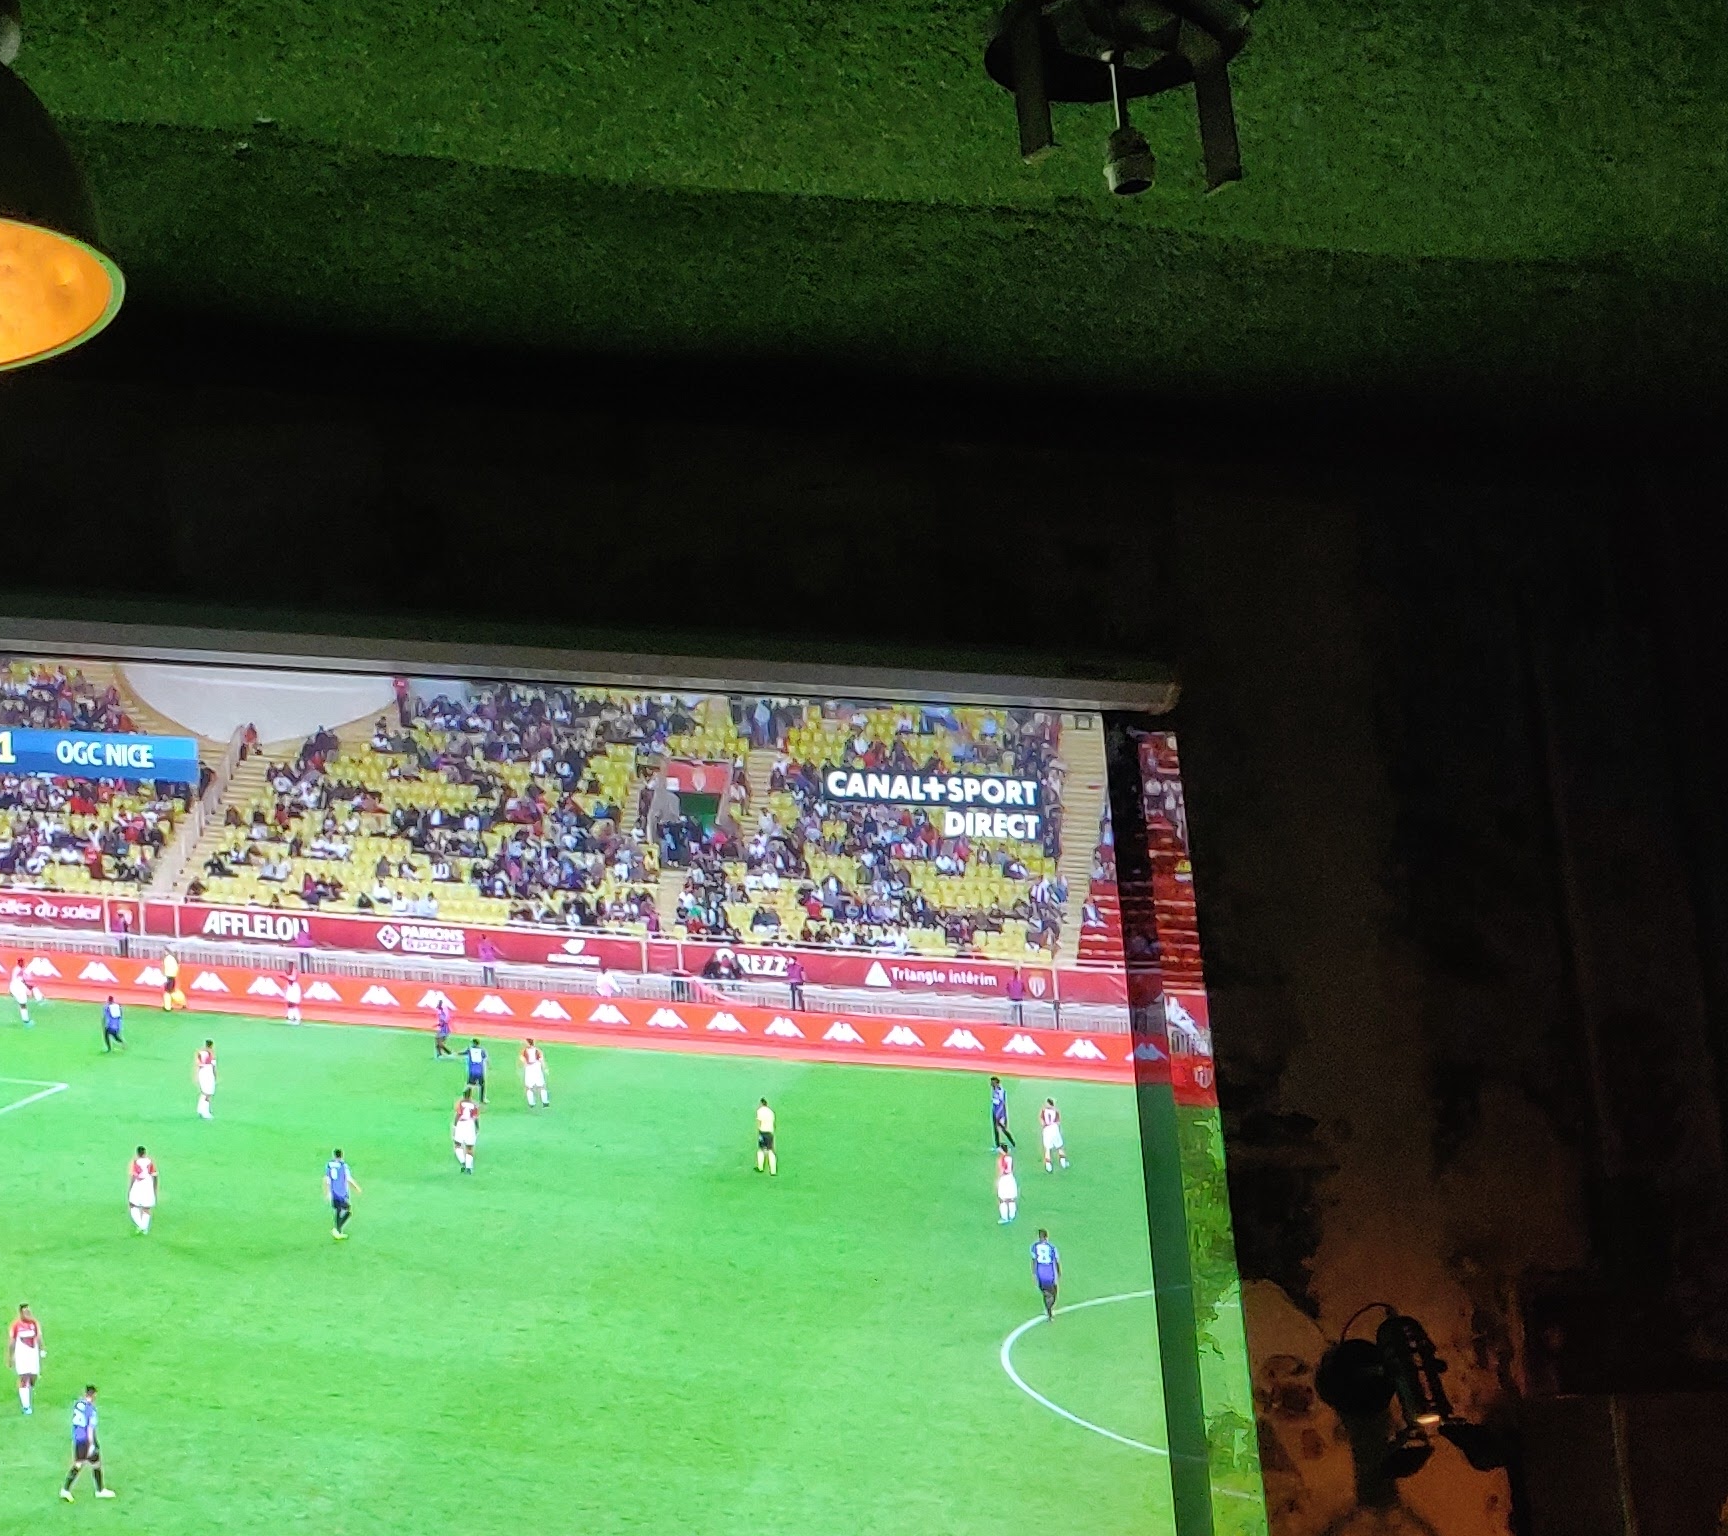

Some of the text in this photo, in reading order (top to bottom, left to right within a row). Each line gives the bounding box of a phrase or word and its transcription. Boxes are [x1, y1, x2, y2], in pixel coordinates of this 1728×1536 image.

[56, 740, 103, 766] OGC
[106, 743, 155, 769] NICE
[827, 770, 1038, 806] CANAL+SPORT
[944, 810, 1040, 840] DIRECT
[34, 902, 58, 918] du
[890, 967, 946, 986] Triangle
